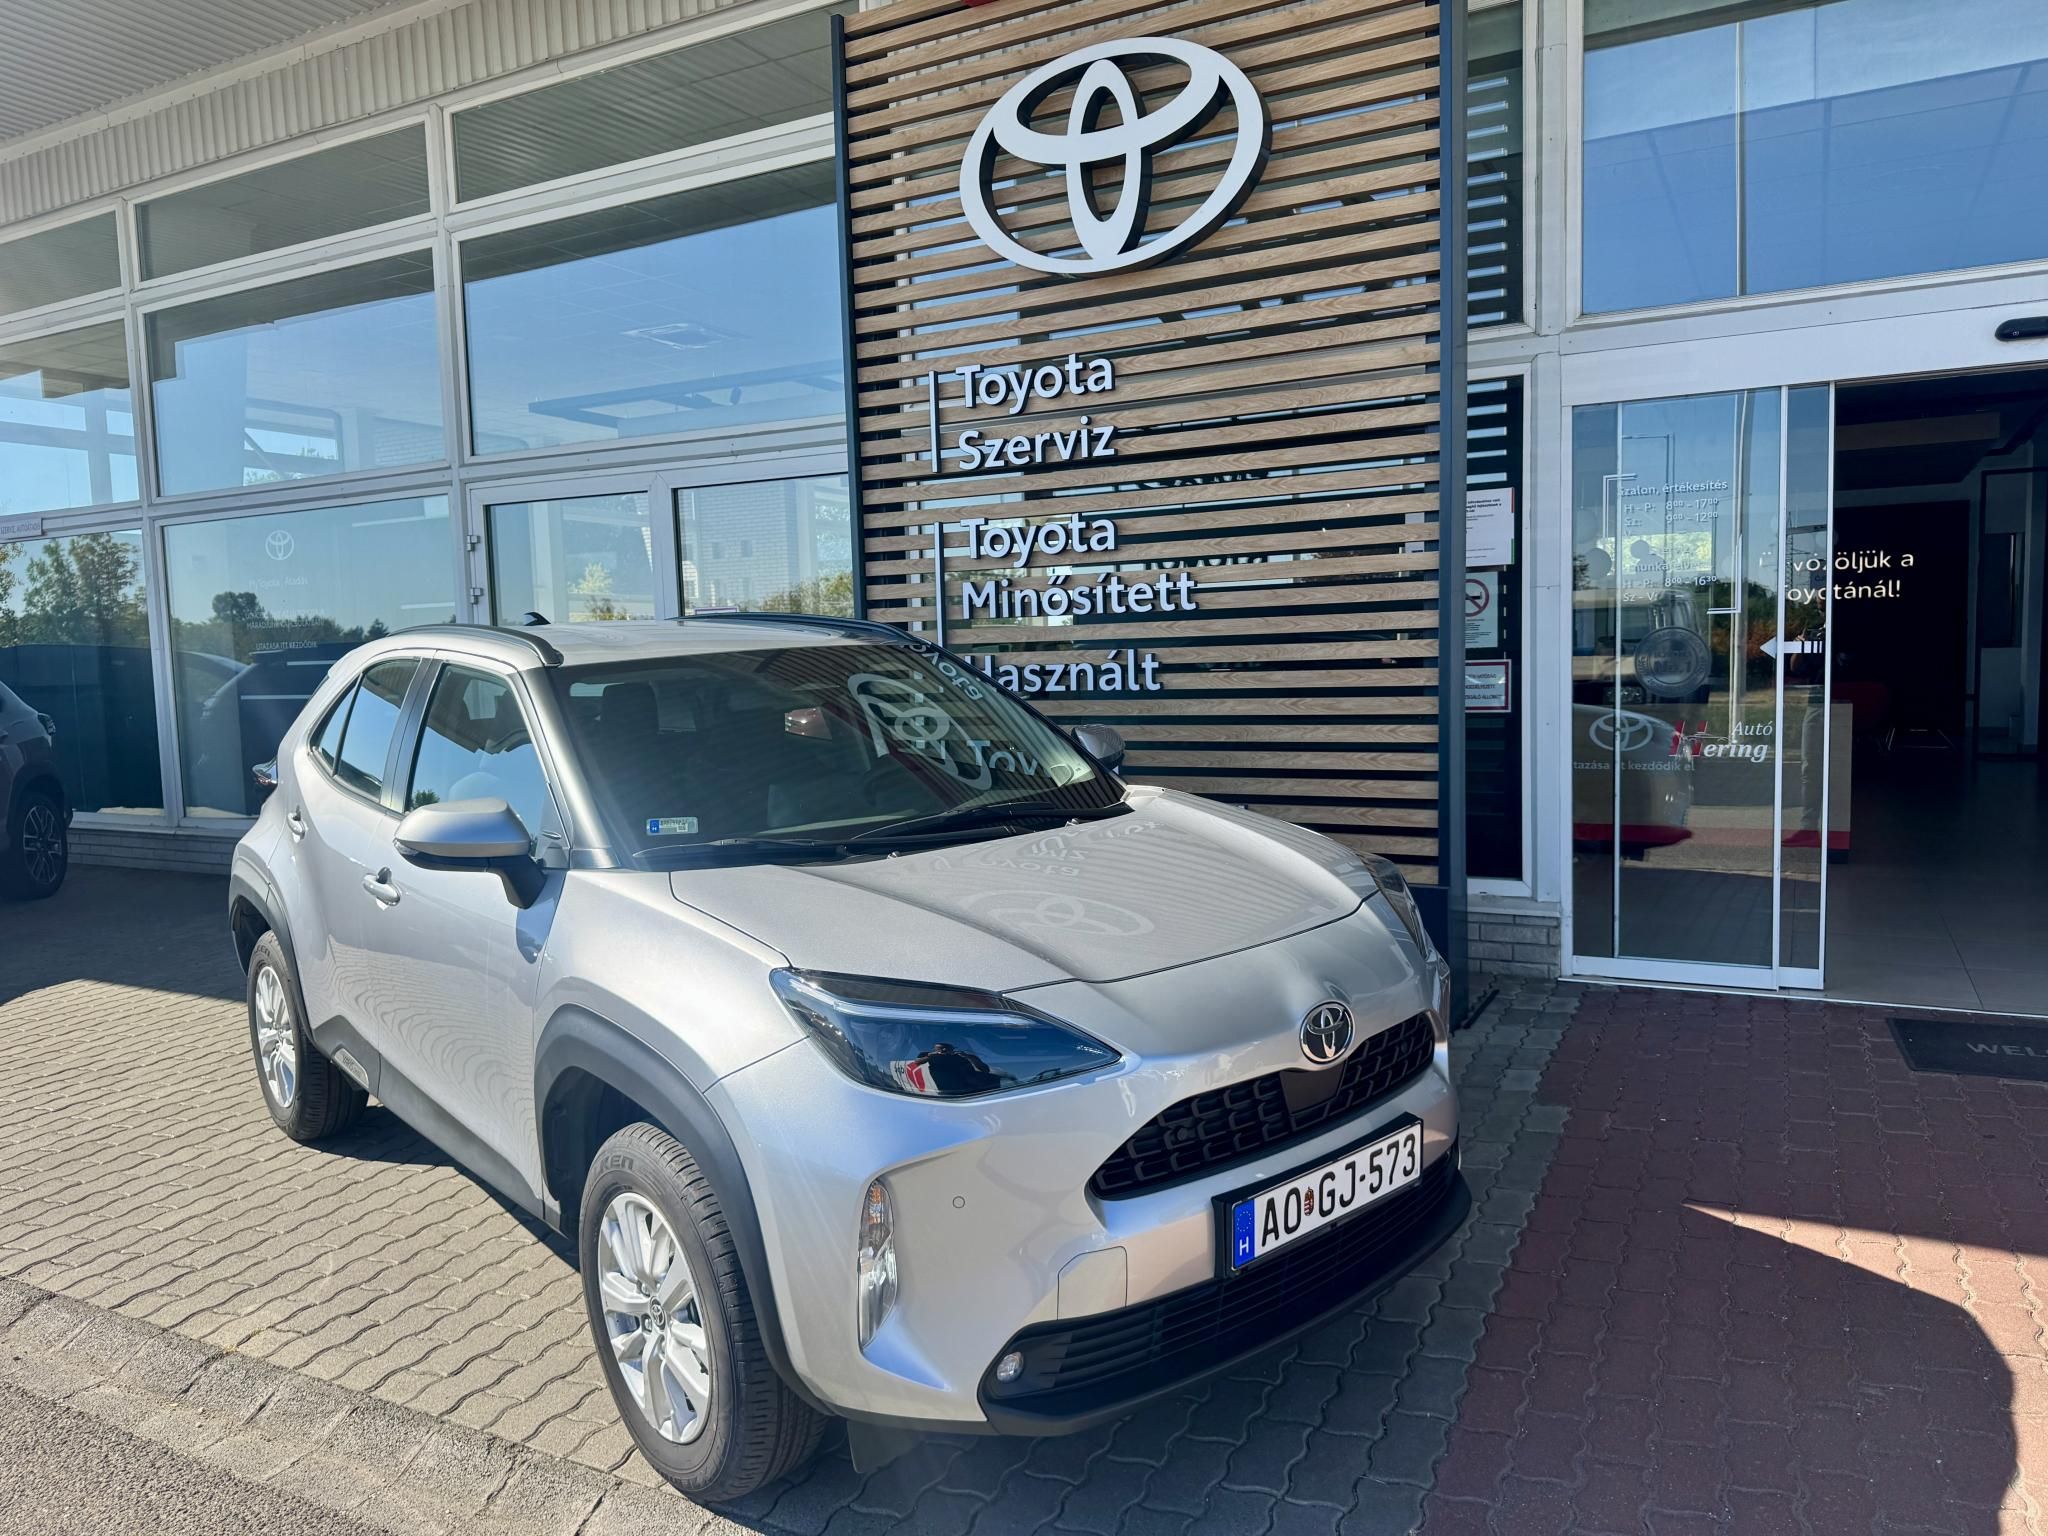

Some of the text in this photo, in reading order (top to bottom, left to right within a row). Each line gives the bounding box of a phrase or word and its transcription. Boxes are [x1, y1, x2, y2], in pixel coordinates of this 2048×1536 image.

[955, 352, 1115, 415] Toyota
[958, 415, 1116, 470] Szerviz
[1662, 480, 1728, 494] értékesítés
[960, 512, 1117, 568] Toyota
[1900, 553, 1914, 568] a
[961, 572, 1198, 620] Minősített
[1784, 579, 1901, 605] oyotánál!
[1731, 720, 1773, 737] Autó
[1573, 760, 1611, 771] tazása
[1966, 1042, 2048, 1058] WEL
[1238, 1236, 1250, 1257] H
